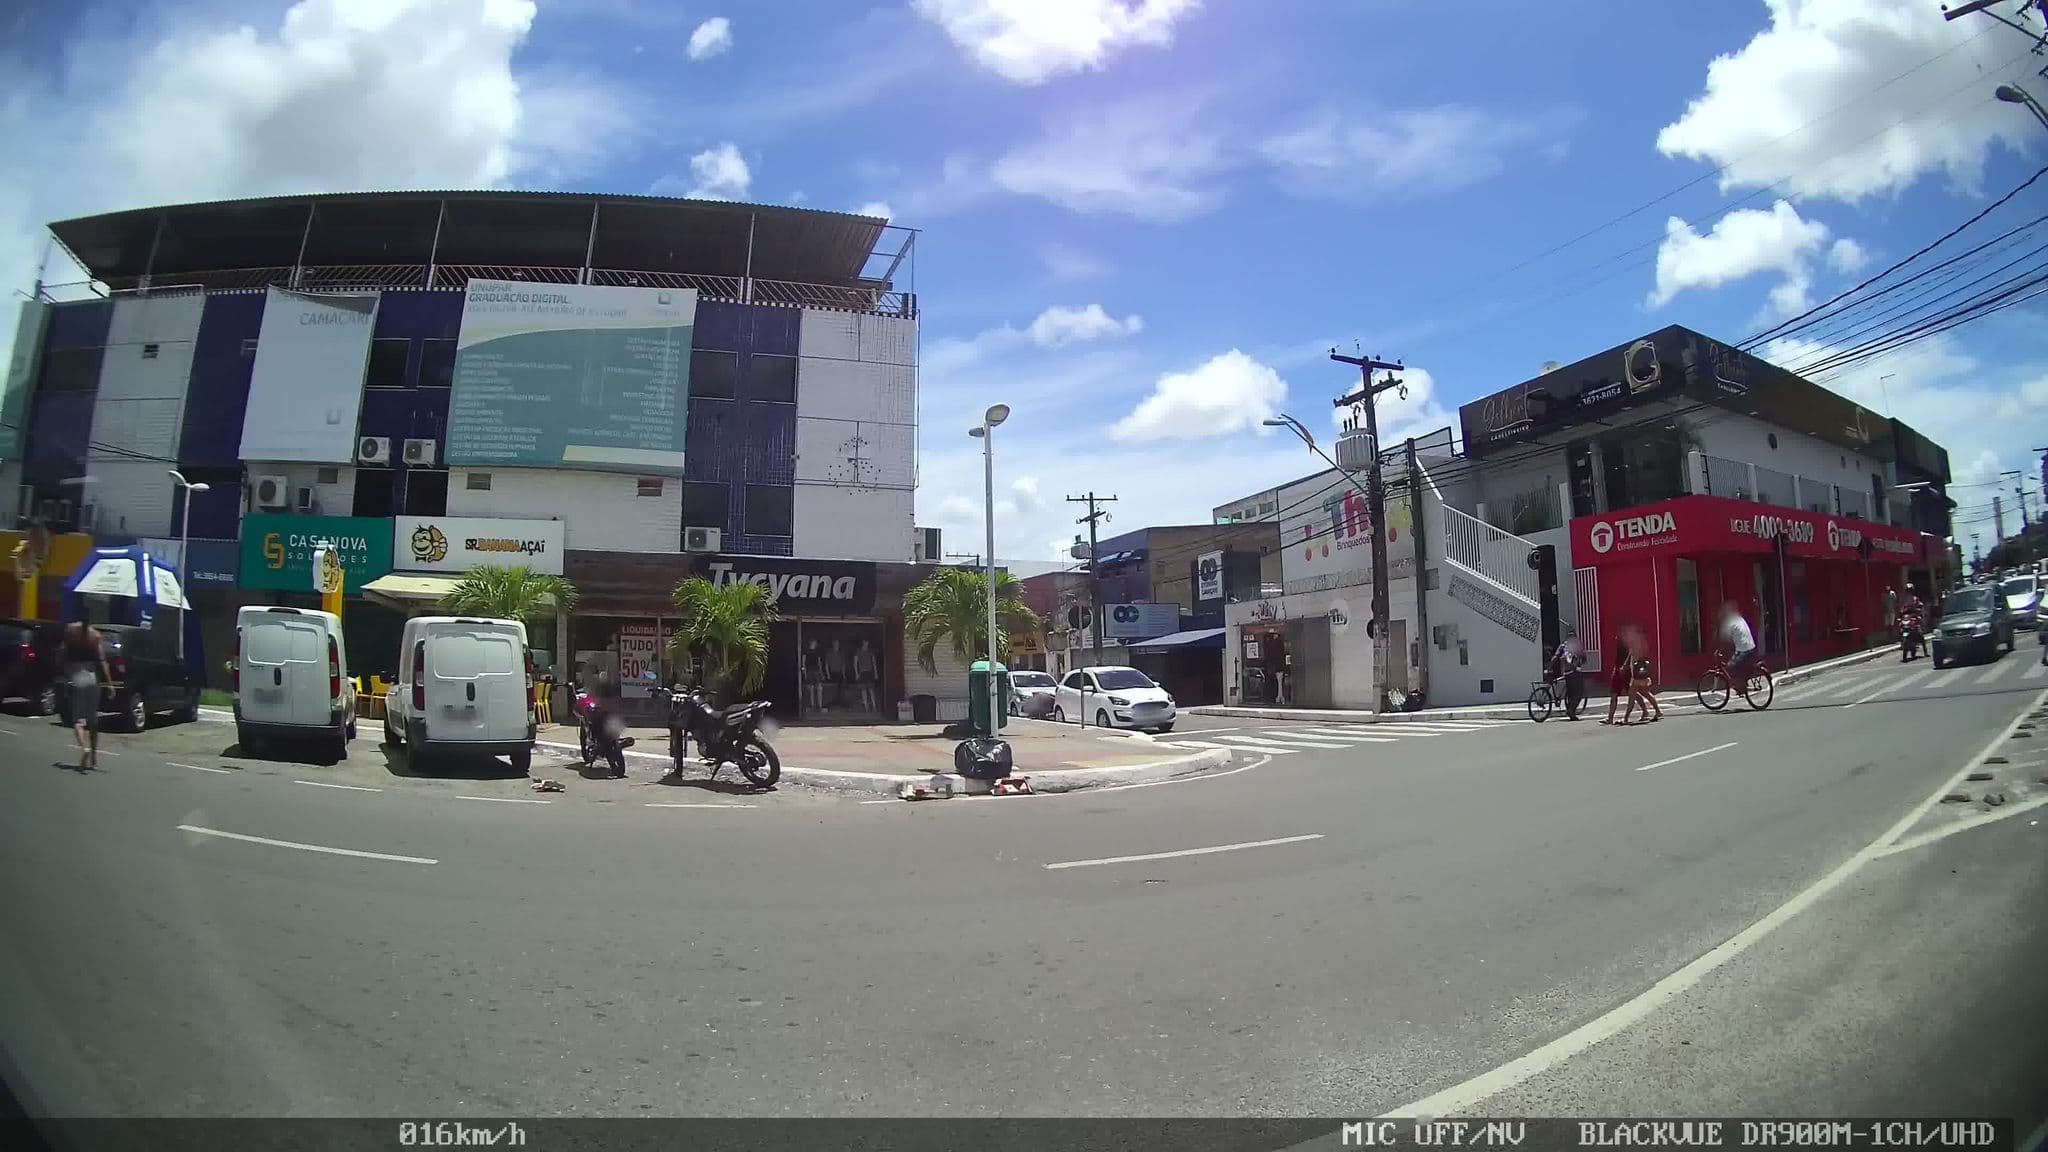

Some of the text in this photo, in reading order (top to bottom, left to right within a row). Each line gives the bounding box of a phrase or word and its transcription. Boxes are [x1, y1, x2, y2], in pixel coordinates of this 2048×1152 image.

[531, 294, 569, 304] DIGITAL
[1615, 511, 1677, 539] TENDA
[622, 639, 653, 651] TUDO
